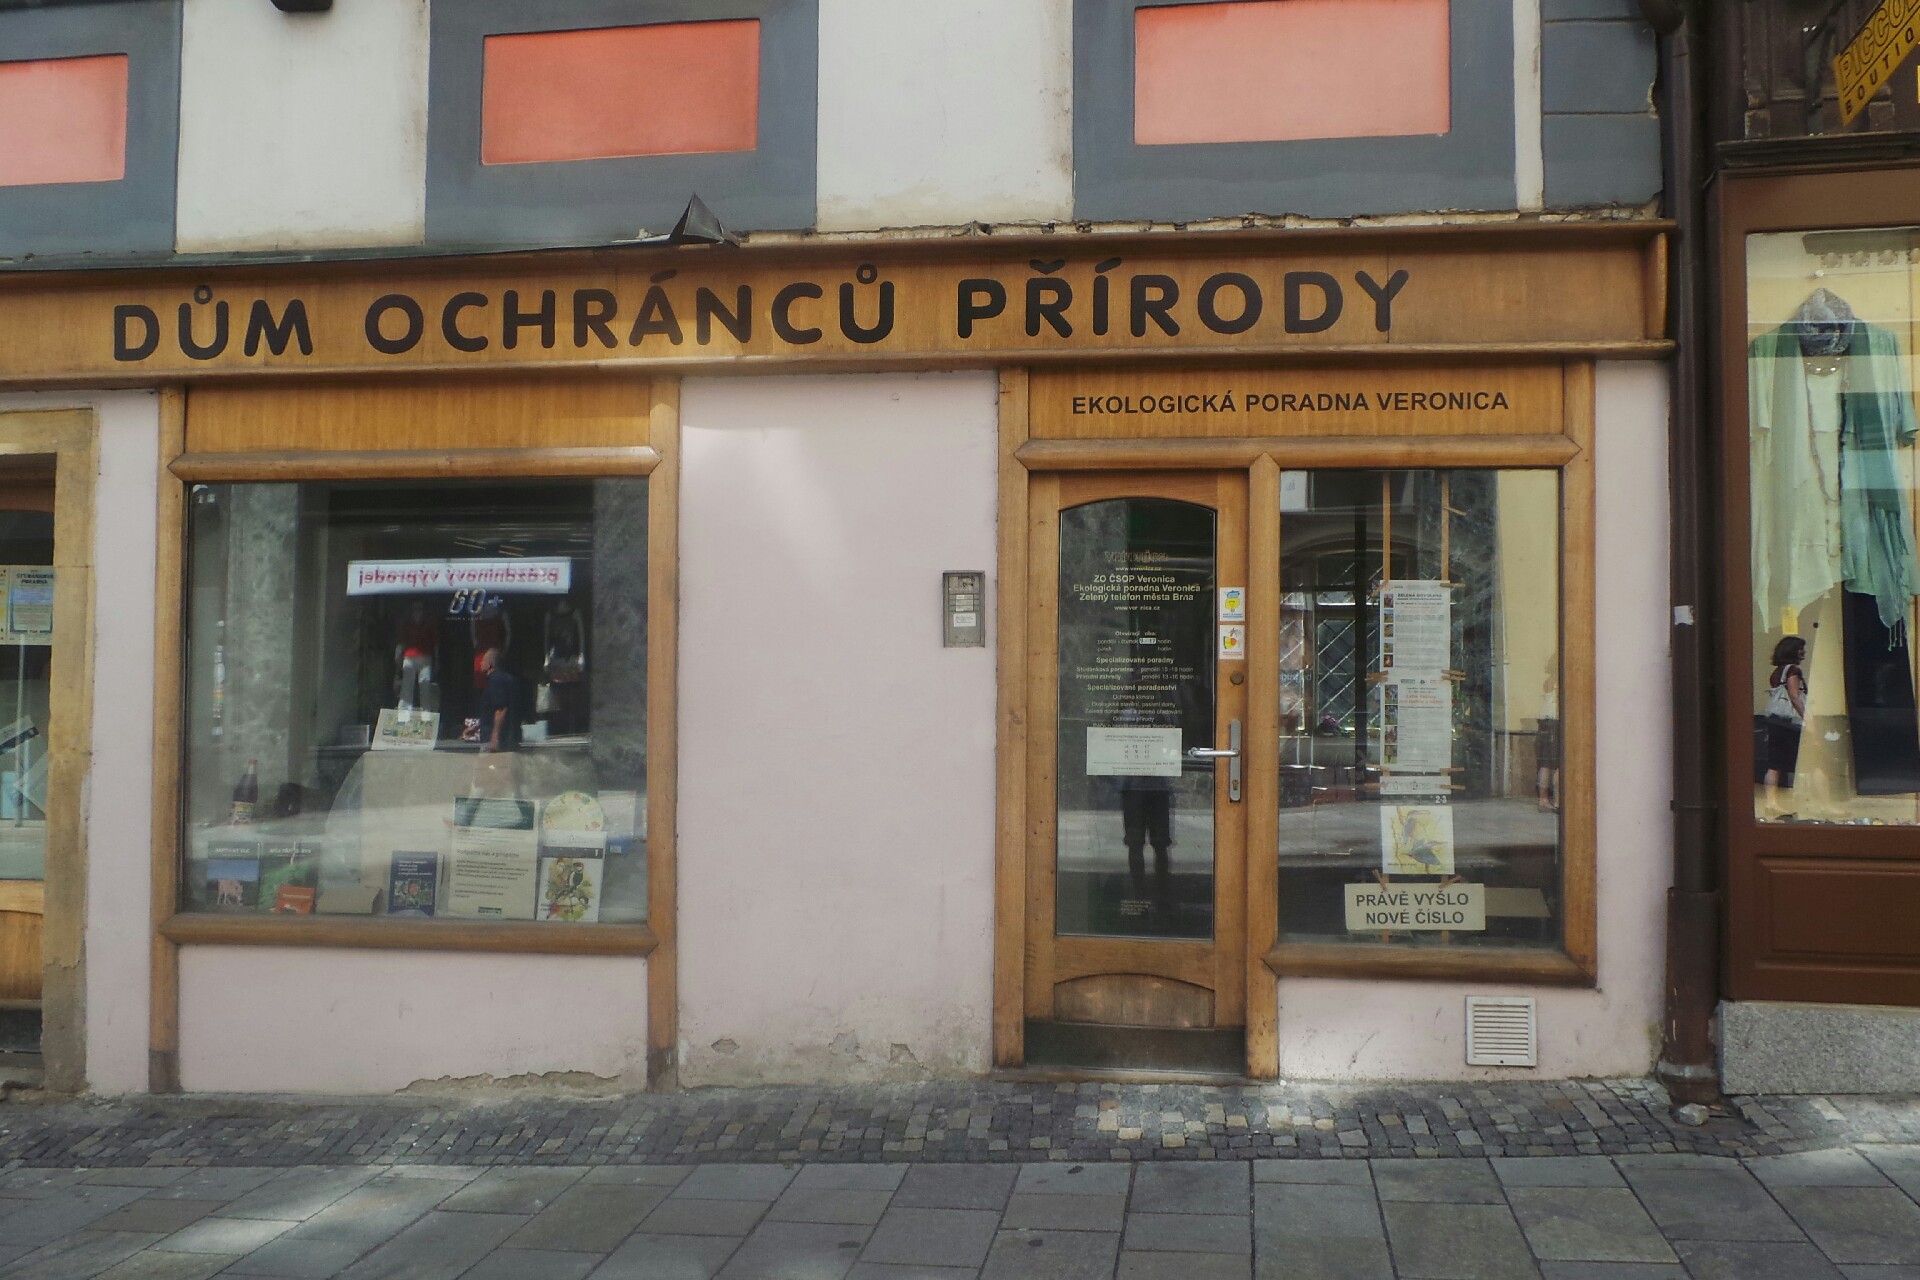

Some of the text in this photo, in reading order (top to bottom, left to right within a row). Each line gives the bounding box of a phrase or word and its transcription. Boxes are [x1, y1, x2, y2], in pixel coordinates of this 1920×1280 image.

[114, 256, 1410, 362] DŮM OCHRÁNCŮ PŘÍRODY
[1072, 389, 1510, 415] EKOLOGICKÁ PORADNA VERONICA
[1094, 573, 1176, 583] ZO ČSOP Veronica
[1073, 584, 1201, 593] Ekologická poradna Veronica
[1079, 593, 1194, 603] Zelený telefon města Brna
[1356, 890, 1469, 907] PRÁVĚ VYŠLO
[1365, 908, 1465, 924] NOVÉ ČÍSLO
